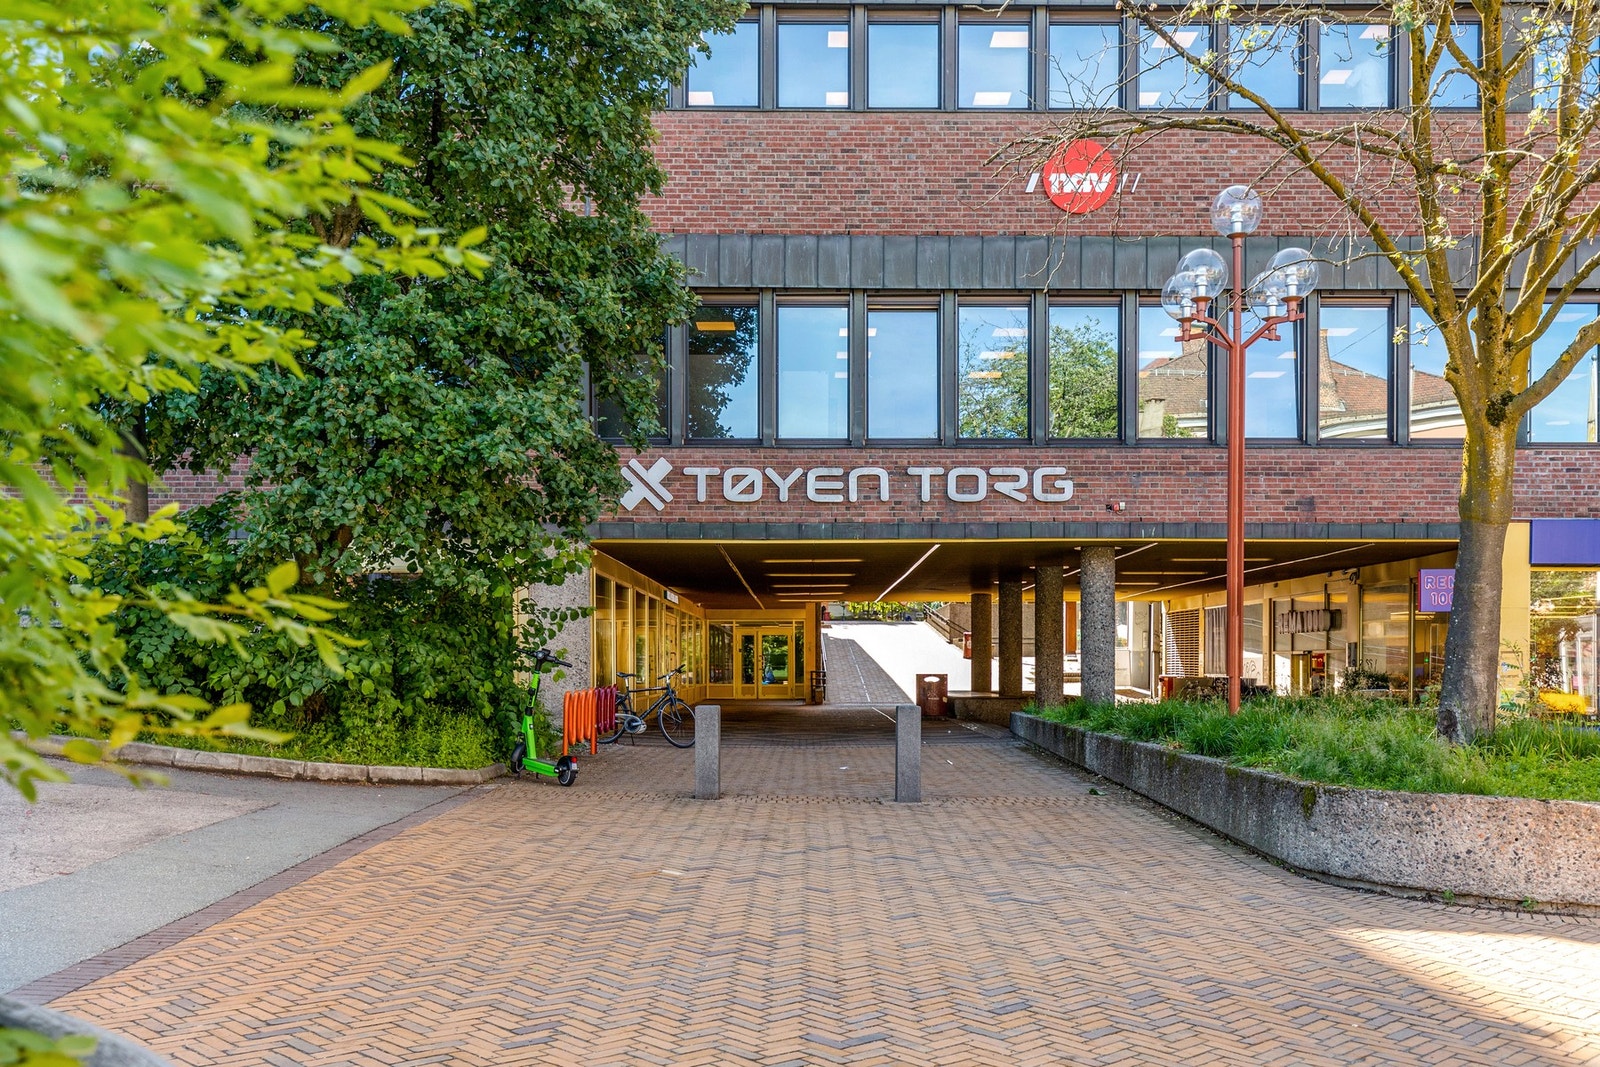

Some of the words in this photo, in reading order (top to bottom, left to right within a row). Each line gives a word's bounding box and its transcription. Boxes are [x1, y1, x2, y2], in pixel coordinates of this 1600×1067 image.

[1048, 172, 1112, 194] nav
[683, 466, 890, 503] TØYEN
[907, 466, 1074, 503] TORG
